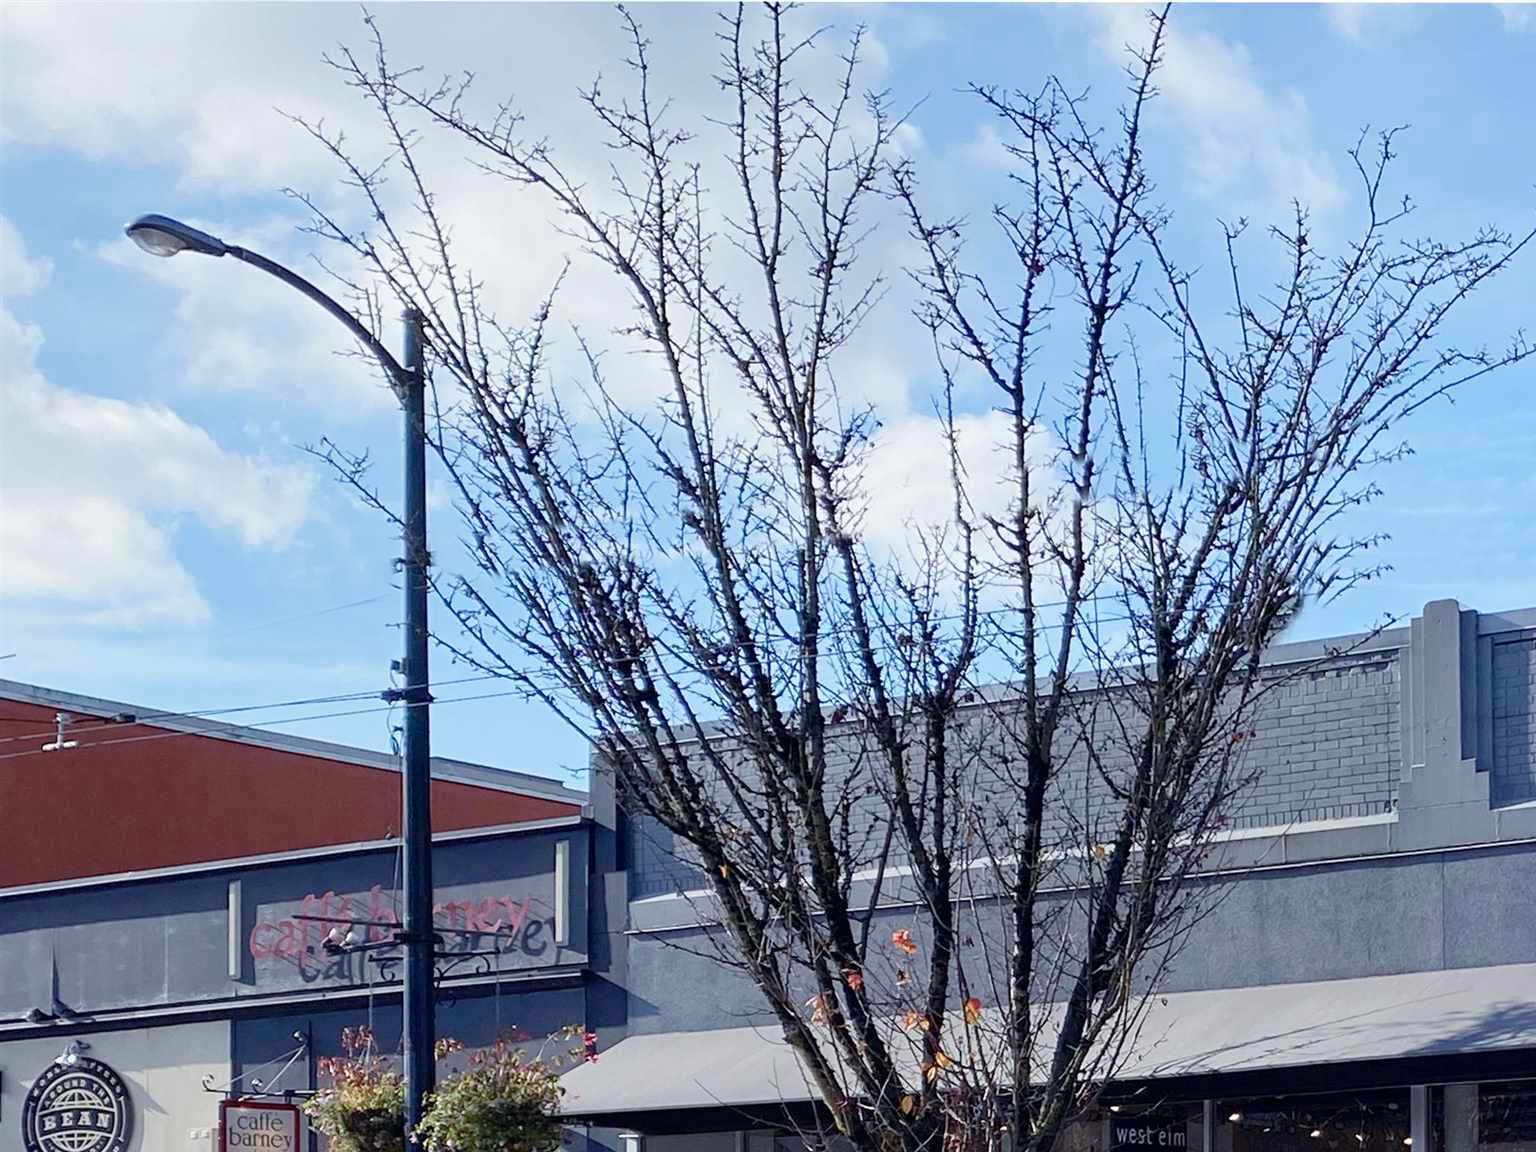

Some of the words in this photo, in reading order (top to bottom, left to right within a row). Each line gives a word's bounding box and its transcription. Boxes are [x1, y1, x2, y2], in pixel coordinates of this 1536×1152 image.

[93, 1083, 110, 1104] THE
[43, 1110, 111, 1131] BEAN
[229, 1126, 291, 1152] barney
[1116, 1126, 1152, 1145] west
[1158, 1126, 1185, 1147] elm
